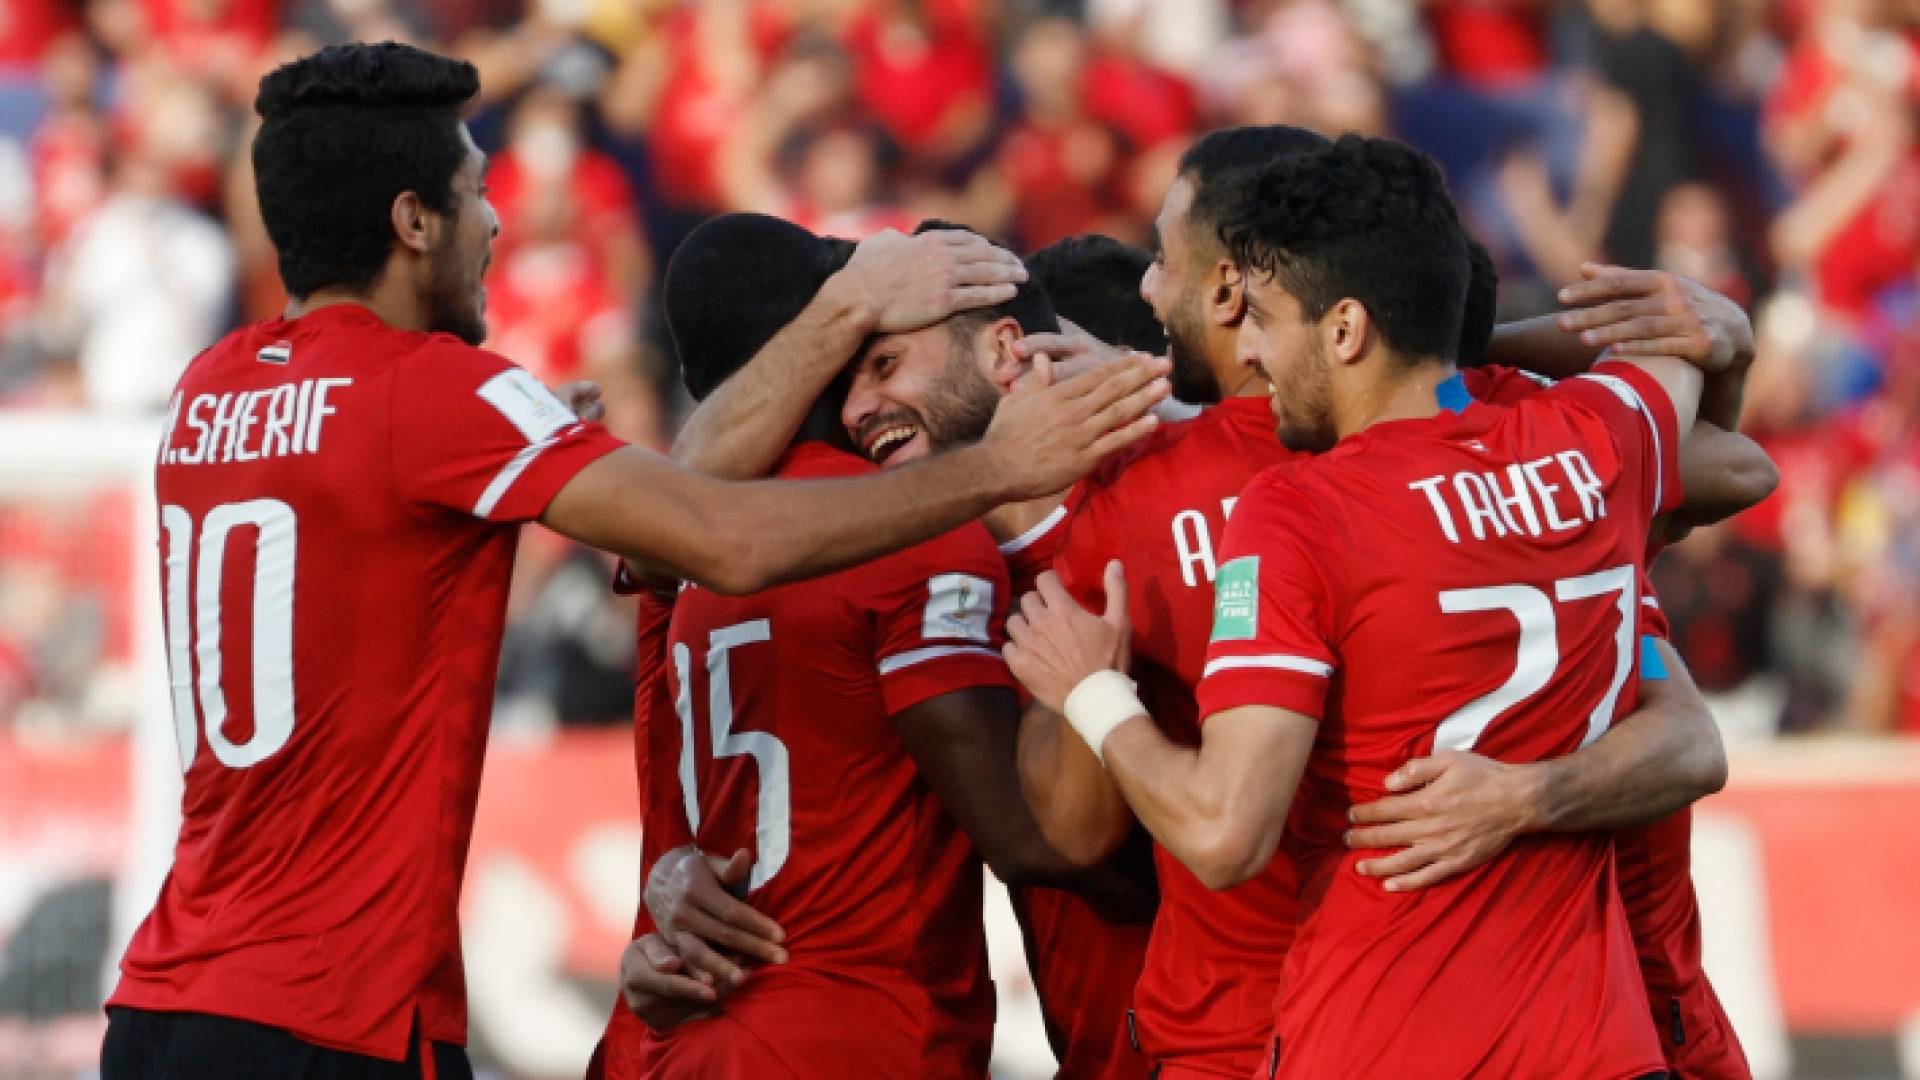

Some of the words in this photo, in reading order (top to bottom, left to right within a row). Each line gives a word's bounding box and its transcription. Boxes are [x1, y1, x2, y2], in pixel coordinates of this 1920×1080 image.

[1408, 449, 1607, 544] TAHER
[162, 497, 297, 774] 10
[1433, 563, 1635, 756] 27
[672, 617, 791, 893] 15
